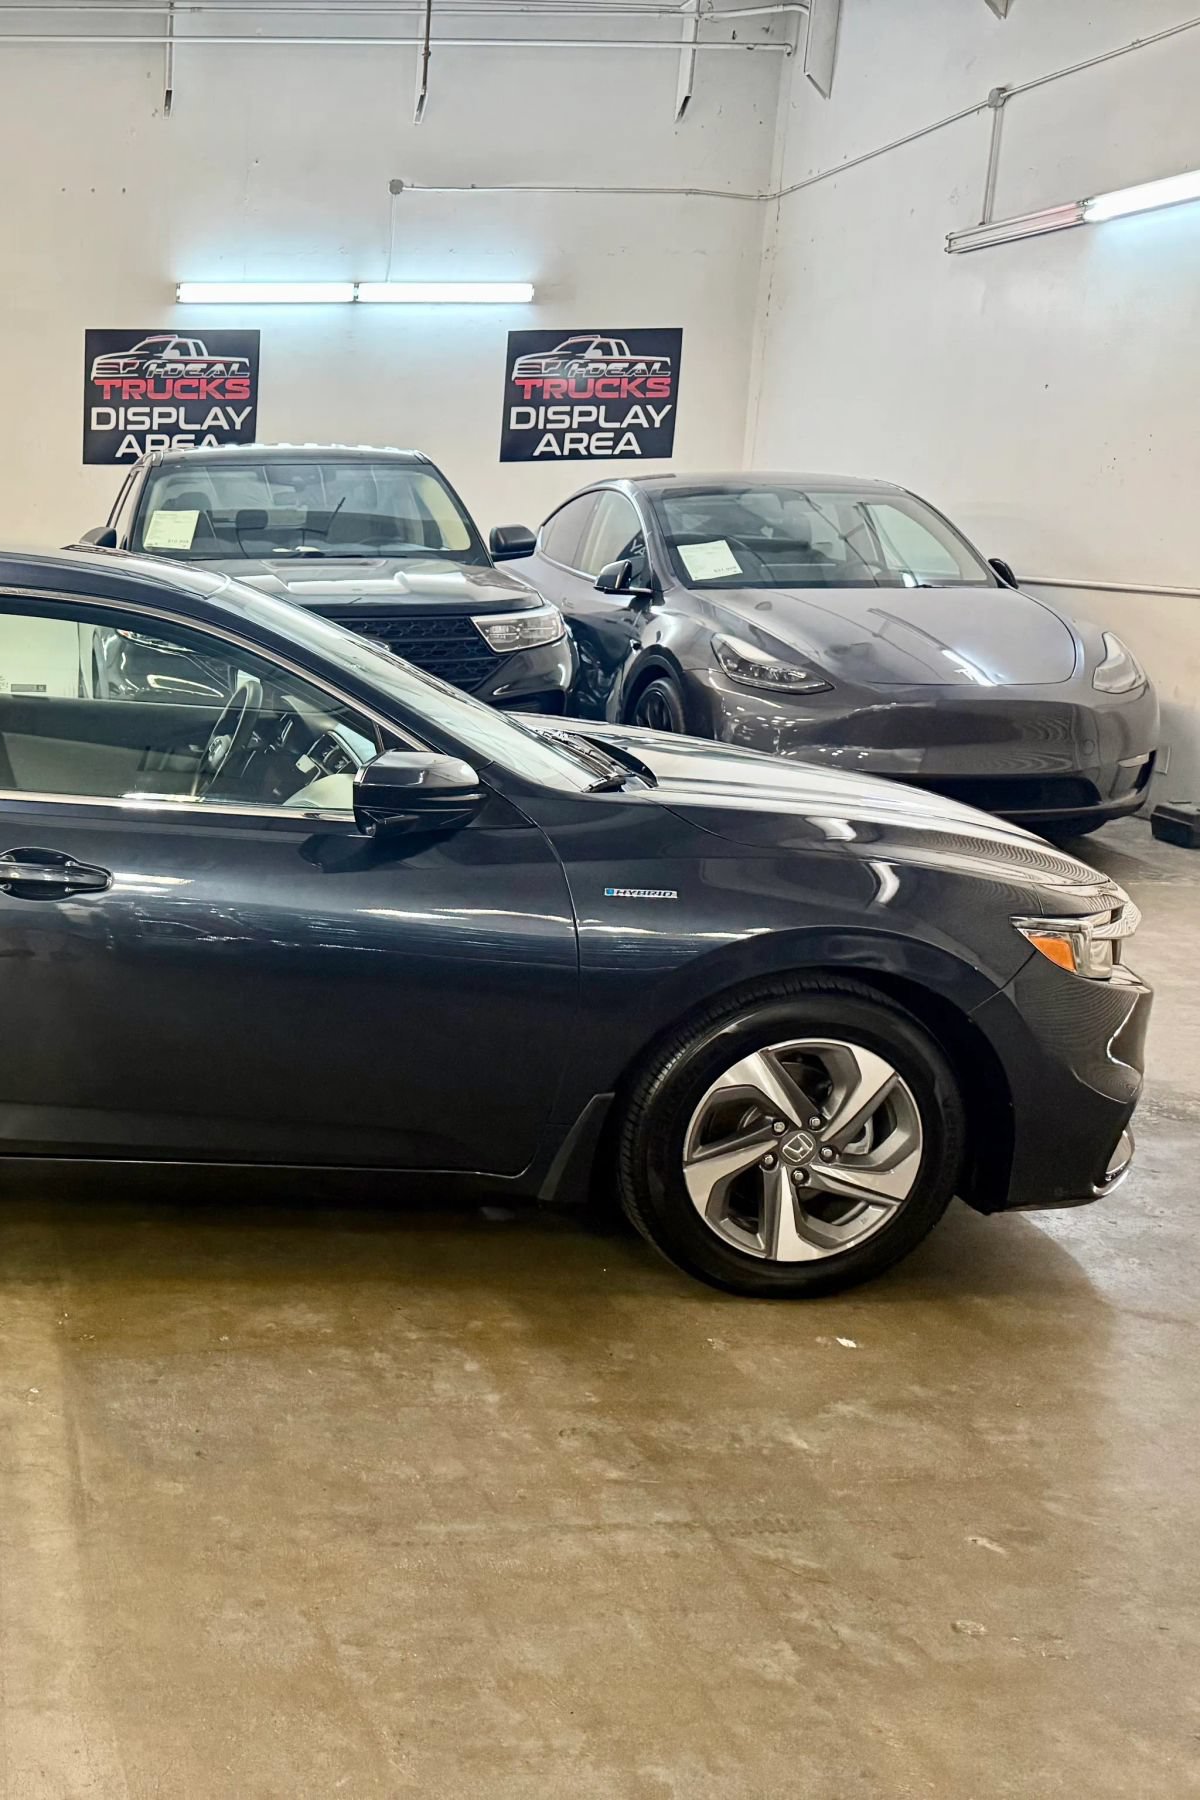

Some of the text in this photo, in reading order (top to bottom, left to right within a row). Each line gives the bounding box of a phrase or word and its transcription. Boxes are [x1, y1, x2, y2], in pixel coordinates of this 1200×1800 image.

[94, 378, 251, 400] TRUCKS
[514, 378, 672, 400] TRUCKS
[90, 406, 253, 431] DISPLAY
[509, 404, 673, 430] DISPLAY
[532, 431, 642, 457] AREA
[615, 888, 675, 898] HYBRID
